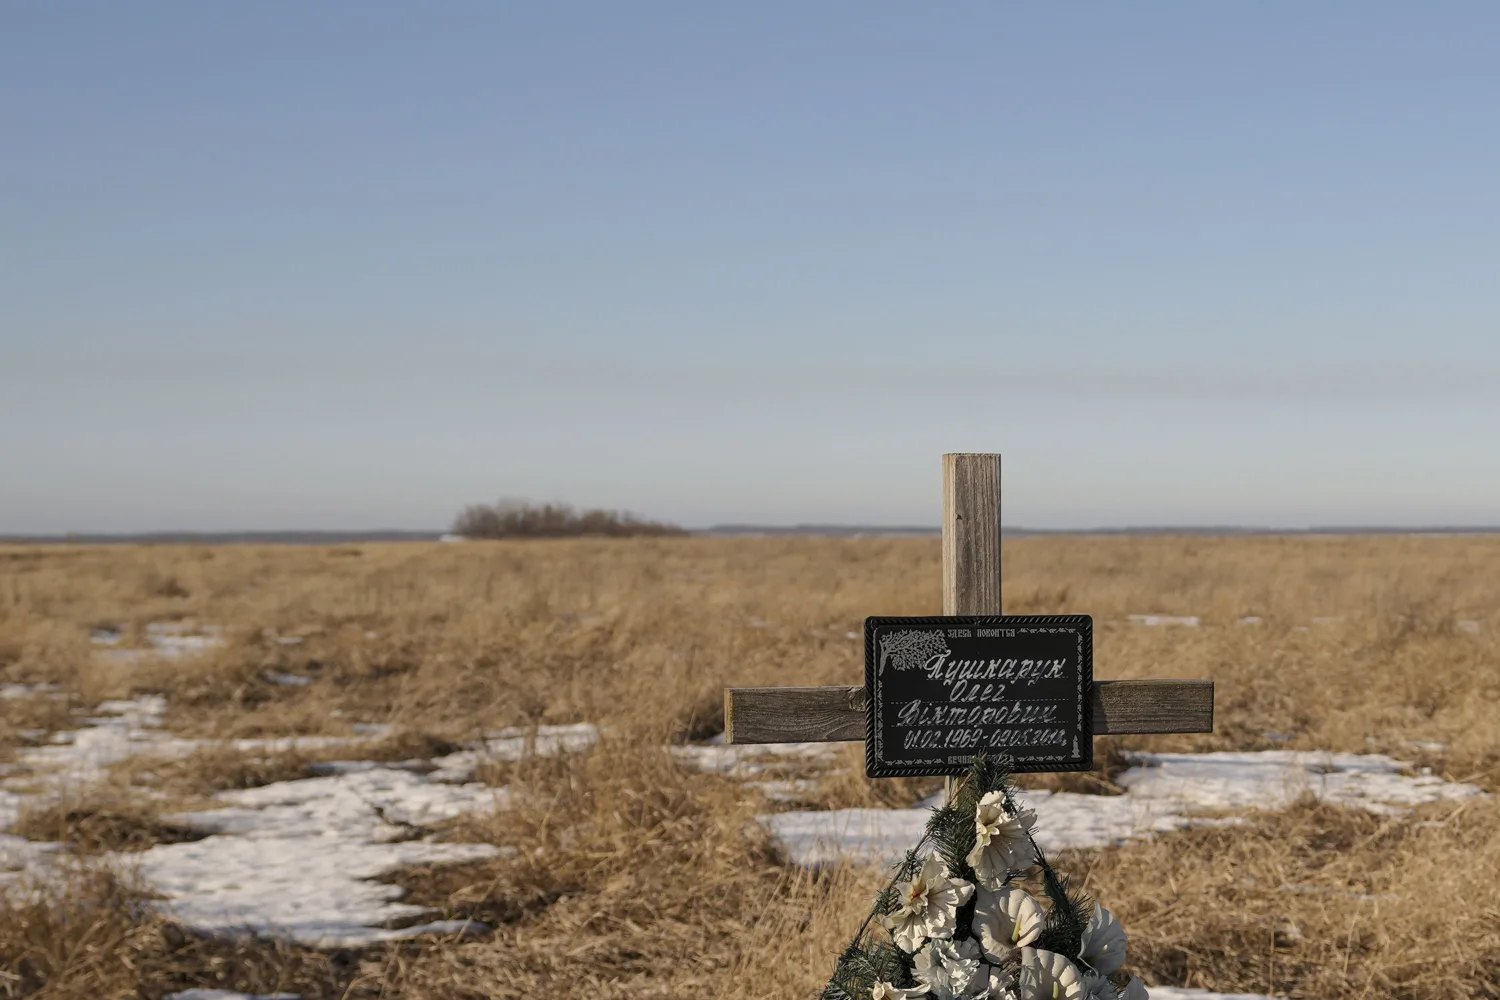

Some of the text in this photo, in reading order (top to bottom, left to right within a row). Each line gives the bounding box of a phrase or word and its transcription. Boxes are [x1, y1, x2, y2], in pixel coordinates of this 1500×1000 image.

[947, 628, 972, 639] ЗДЕСЬ
[923, 649, 1067, 686] Пушкарук
[949, 678, 1006, 702] Олег
